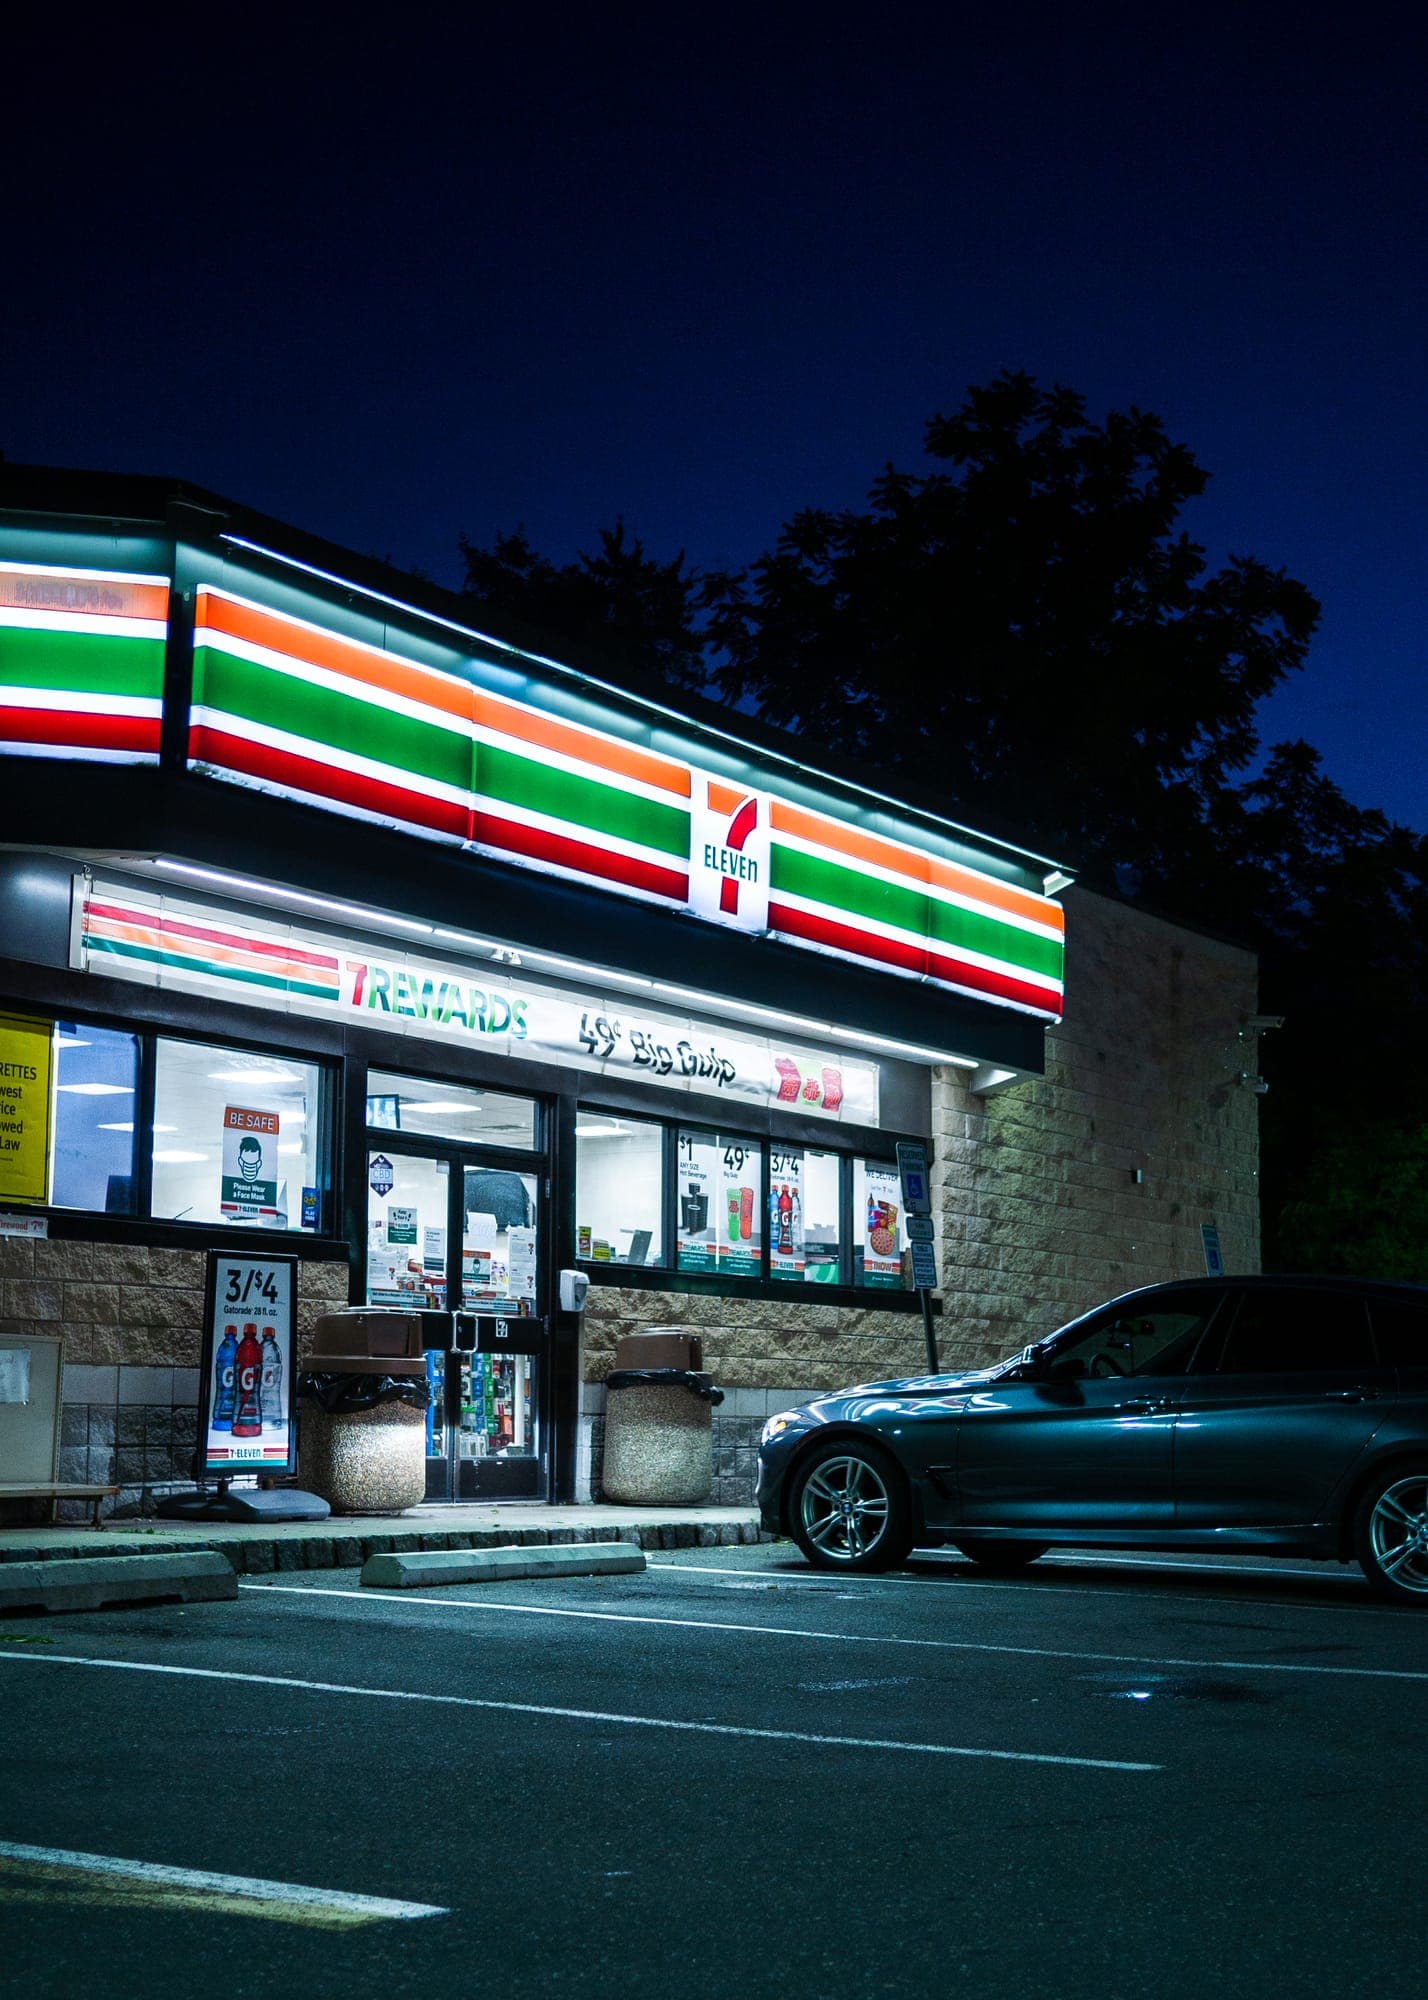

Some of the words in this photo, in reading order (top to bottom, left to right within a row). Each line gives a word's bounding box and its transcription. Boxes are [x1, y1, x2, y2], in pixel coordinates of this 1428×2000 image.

[707, 781, 758, 916] 7
[630, 1029, 674, 1076] Big
[677, 1040, 737, 1087] Gulp
[0, 1120, 24, 1134] wed
[230, 1112, 243, 1126] BE
[246, 1114, 275, 1130] SAFE
[233, 1182, 251, 1191] Please
[252, 1184, 266, 1193] Wear
[238, 1191, 250, 1200] Face
[251, 1193, 265, 1201] Mask
[781, 1210, 789, 1226] G
[225, 1269, 279, 1304] 3/$4
[224, 1305, 251, 1316] Gatorade
[222, 1366, 234, 1388] G
[241, 1367, 255, 1391] G
